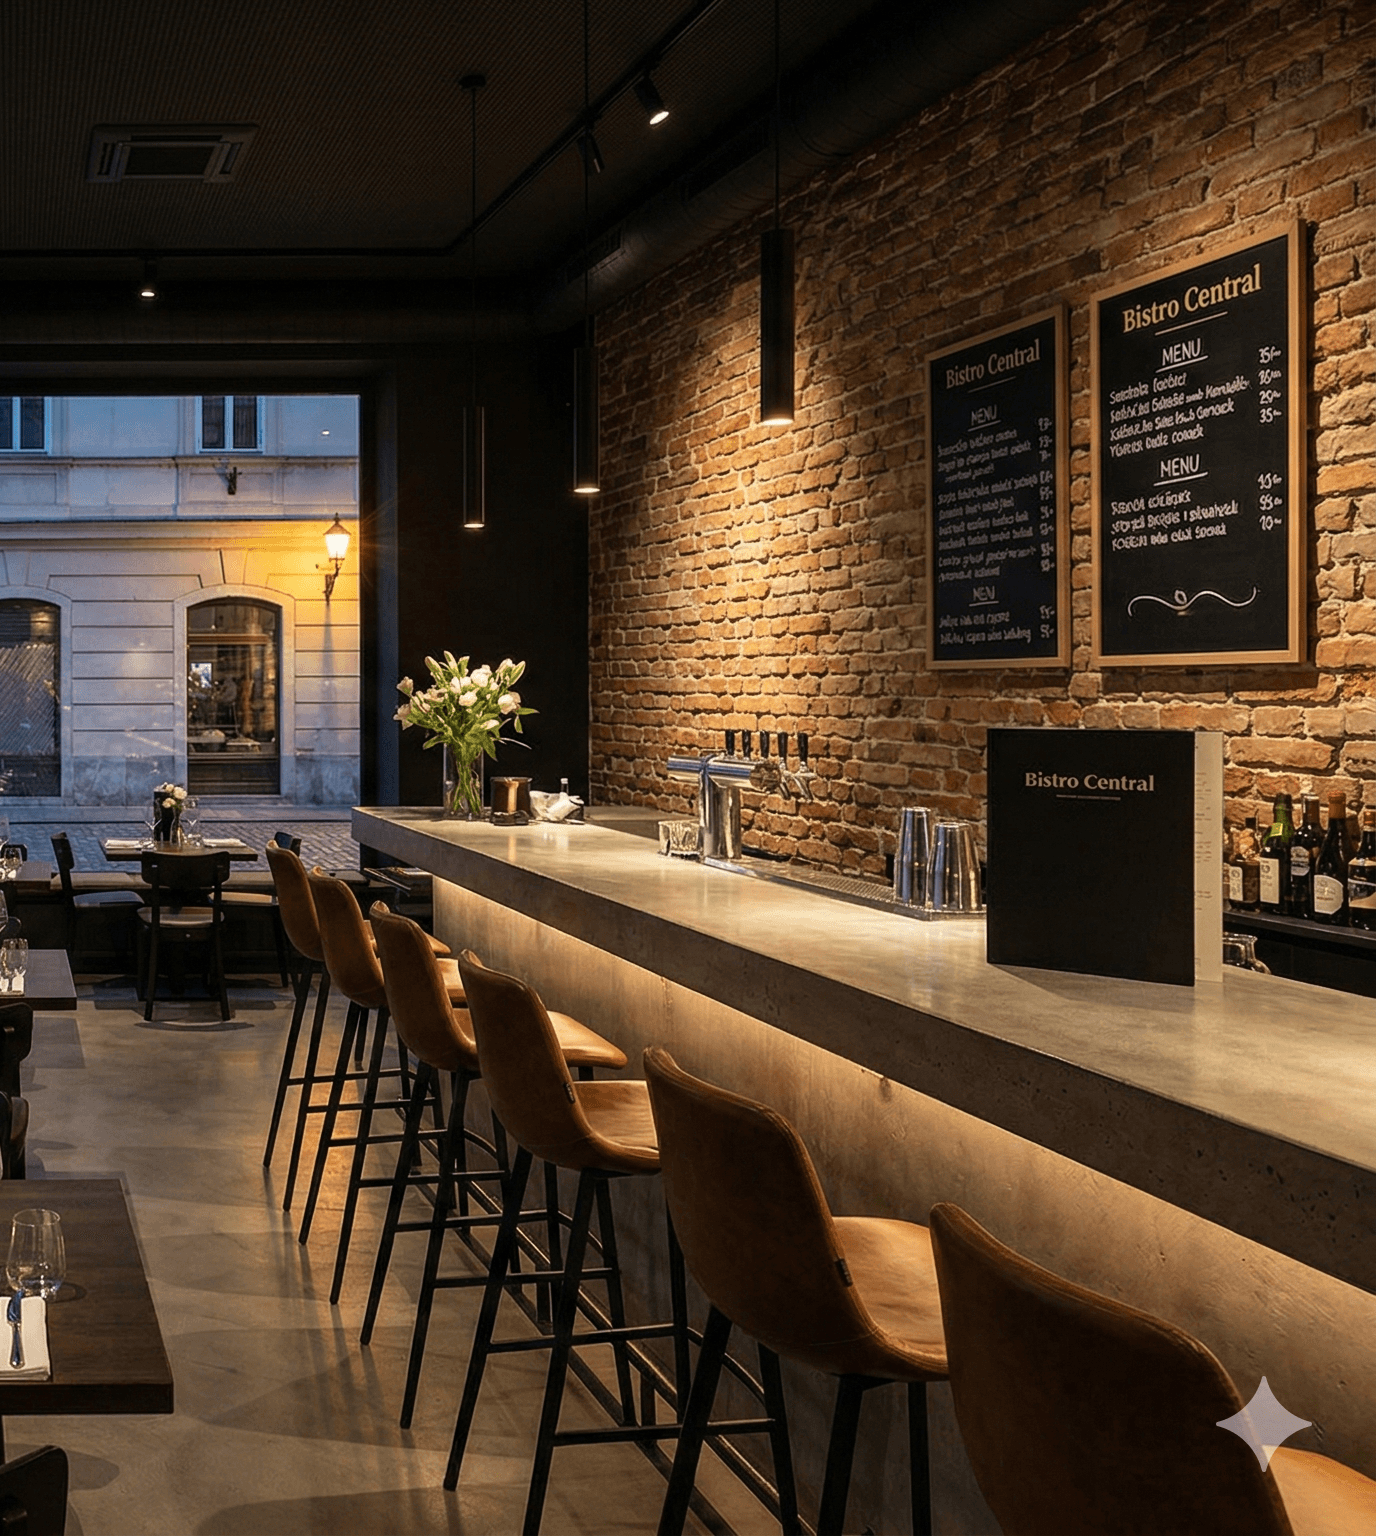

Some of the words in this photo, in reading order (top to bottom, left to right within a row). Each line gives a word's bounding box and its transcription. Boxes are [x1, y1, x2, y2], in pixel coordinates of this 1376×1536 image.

[1122, 299, 1180, 333] Bistro
[1184, 263, 1262, 312] Central
[945, 363, 985, 389] Bistro
[987, 338, 1041, 375] Central
[1162, 337, 1202, 366] MENU
[1160, 453, 1200, 478] MENU
[1024, 771, 1079, 789] Bistro
[1084, 774, 1155, 792] Central
